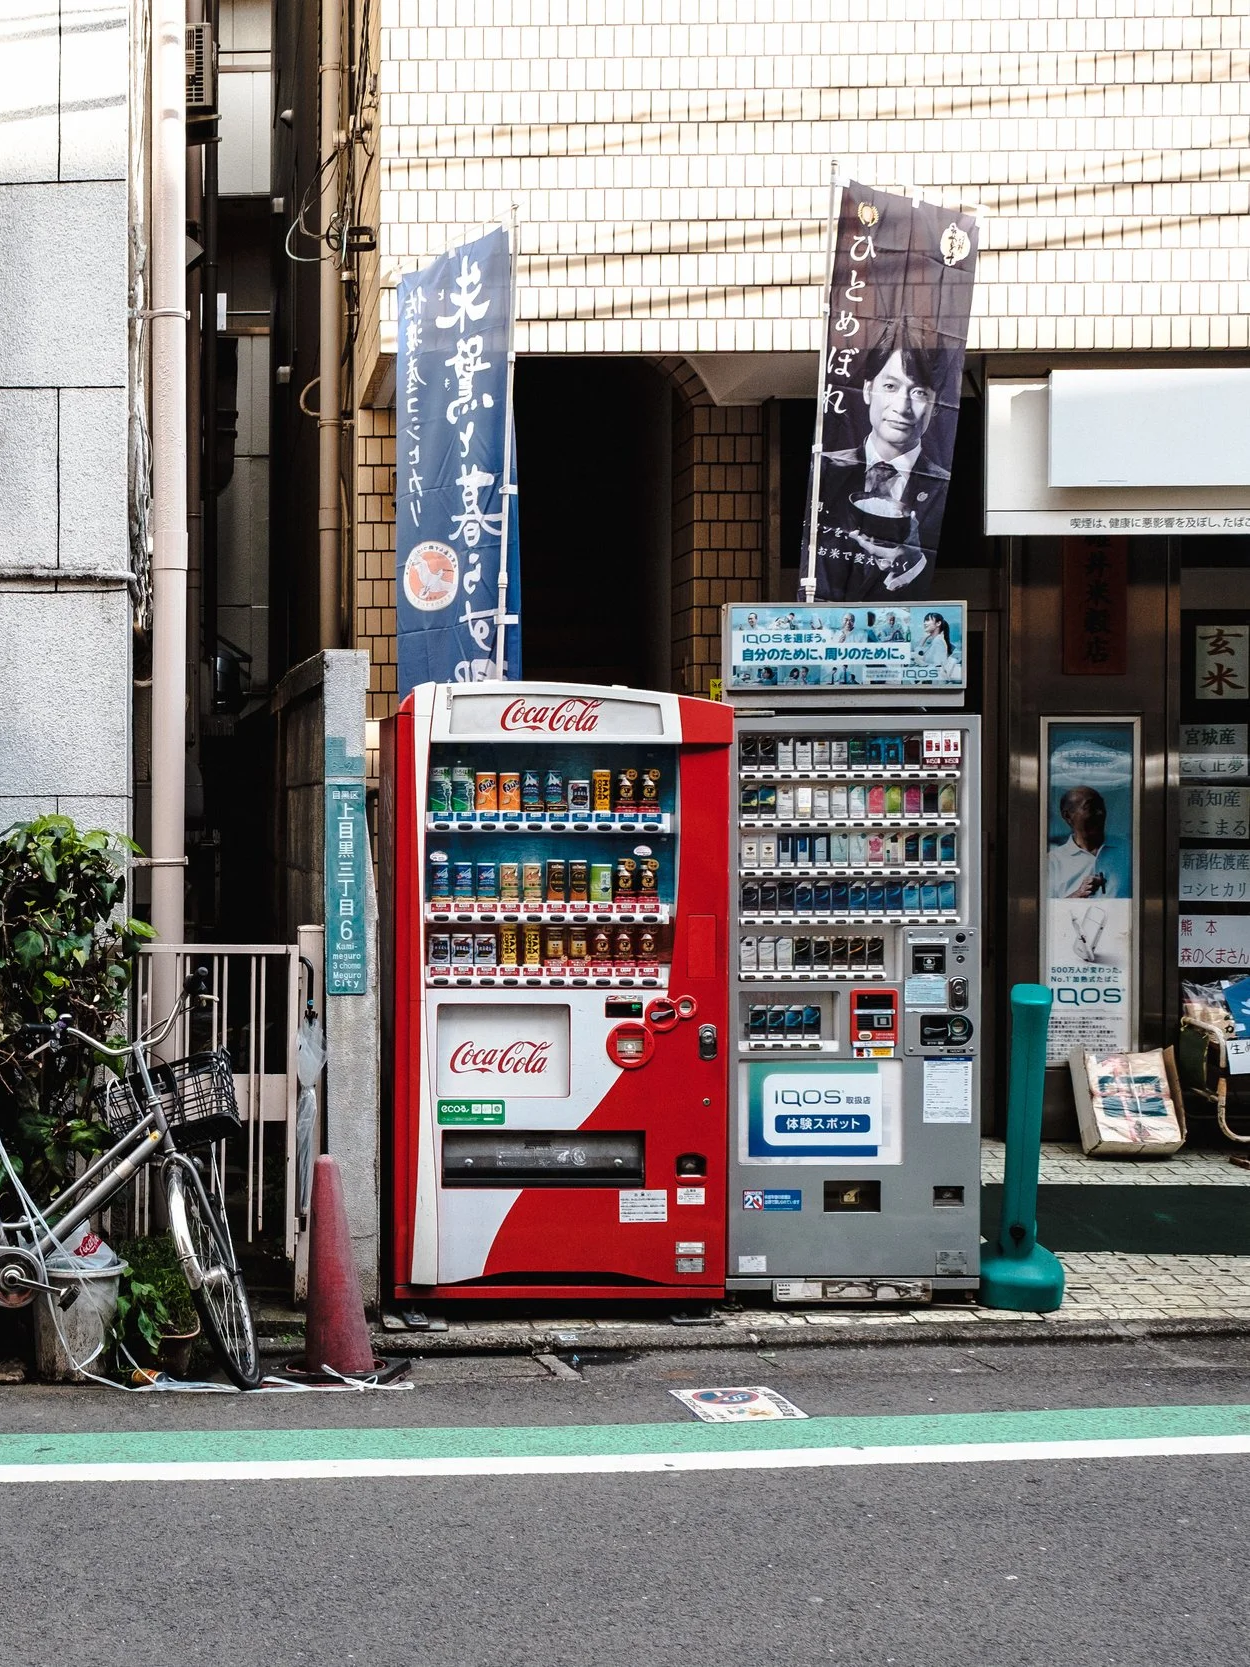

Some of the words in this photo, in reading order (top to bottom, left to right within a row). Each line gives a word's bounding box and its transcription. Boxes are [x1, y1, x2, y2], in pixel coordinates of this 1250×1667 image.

[823, 233, 876, 415] ひとめぼれ
[742, 647, 906, 662] 自分のために、周りのために。
[1198, 628, 1246, 696] 玄米
[902, 669, 939, 679] IQOS
[500, 698, 605, 732] Coca-Cola
[1185, 728, 1236, 746] 宮城産
[332, 790, 359, 800] 目黒区
[1188, 789, 1241, 808] 高知産
[1182, 853, 1250, 871] 新潟佐渡産
[1182, 883, 1247, 899] コシヒカリ
[335, 942, 358, 950] Kami-
[332, 953, 361, 961] meguro
[1180, 947, 1250, 965] 森のくまさん
[333, 971, 362, 980] Meguro
[334, 979, 360, 988] City
[1051, 987, 1121, 1006] IQOS
[450, 1040, 553, 1074] Coca-Cola
[774, 1089, 842, 1107] IQOS
[845, 1095, 871, 1105] 取扱店
[786, 1117, 861, 1131] 体験スポット
[744, 1195, 762, 1209] 20
